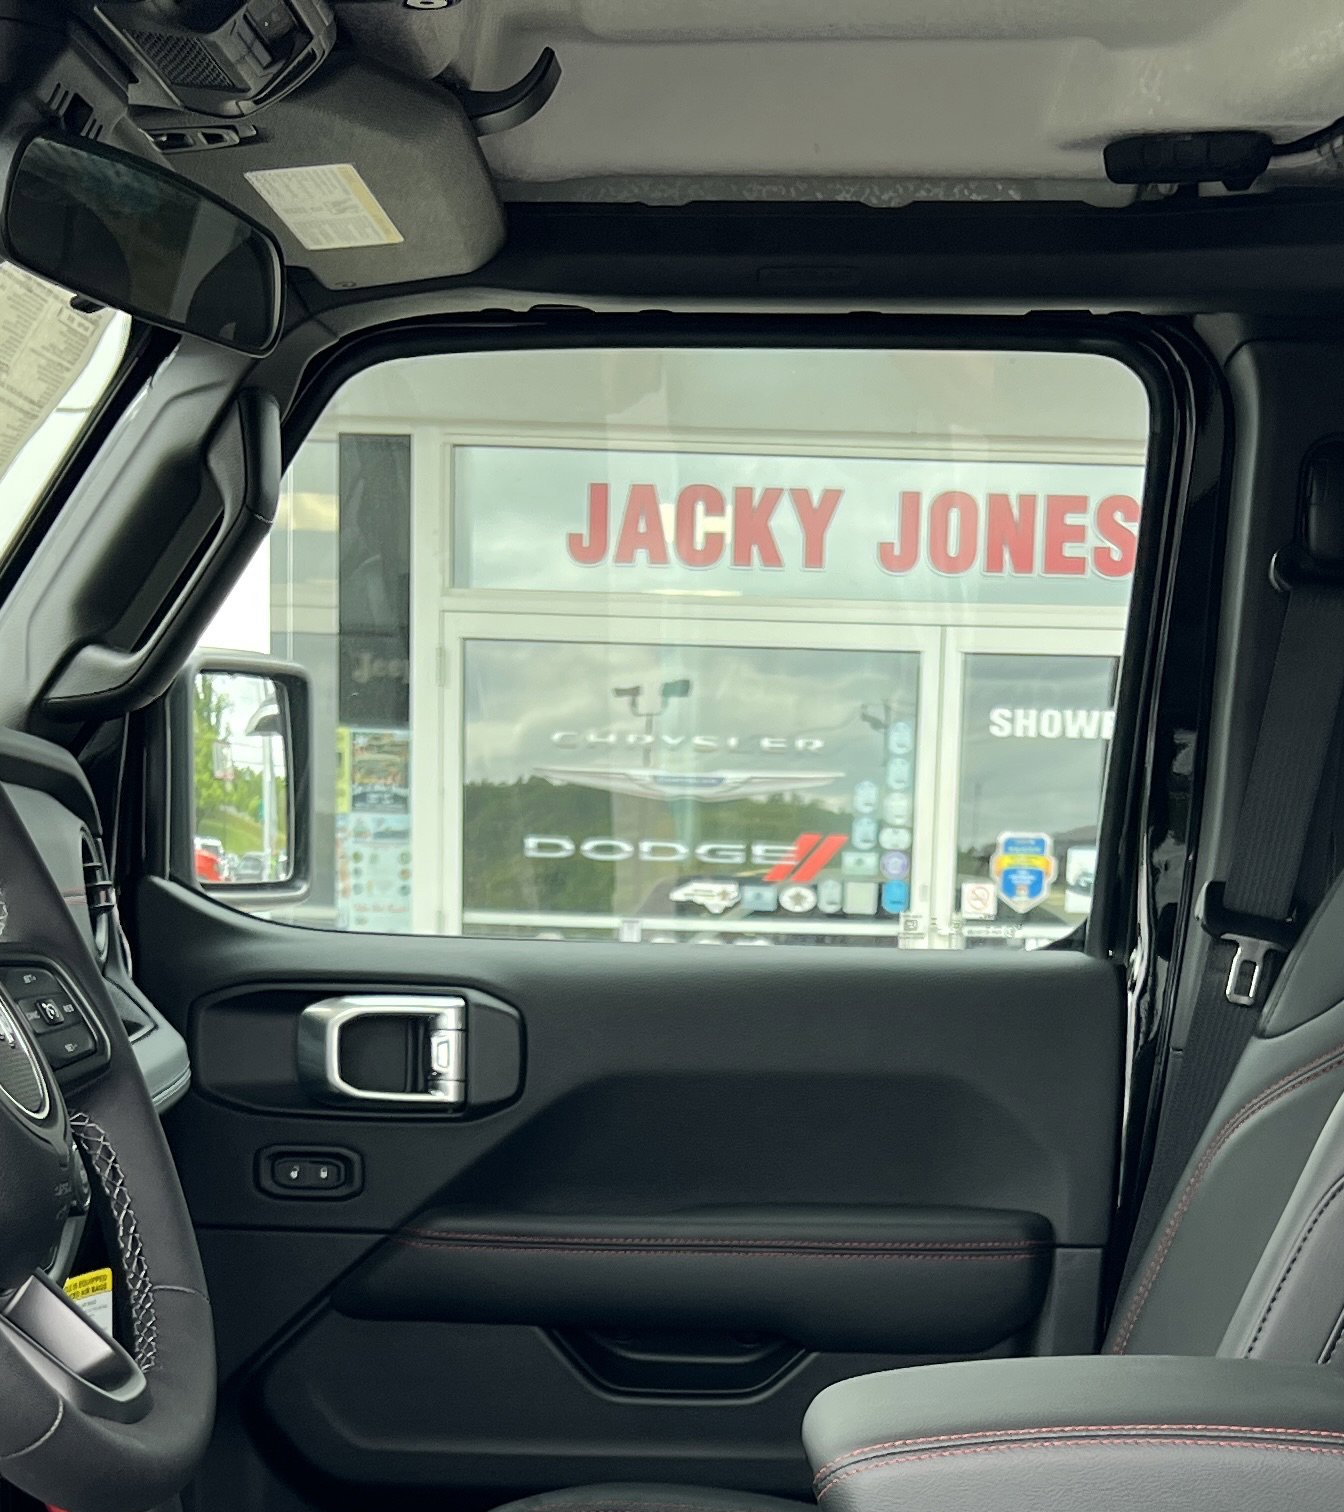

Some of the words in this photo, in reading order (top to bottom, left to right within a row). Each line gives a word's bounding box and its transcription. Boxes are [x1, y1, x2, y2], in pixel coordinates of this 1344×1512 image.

[565, 482, 846, 571] JACKY
[877, 490, 1141, 579] JONES
[551, 731, 825, 751] CHRYSLER
[523, 834, 800, 864] DODGE
